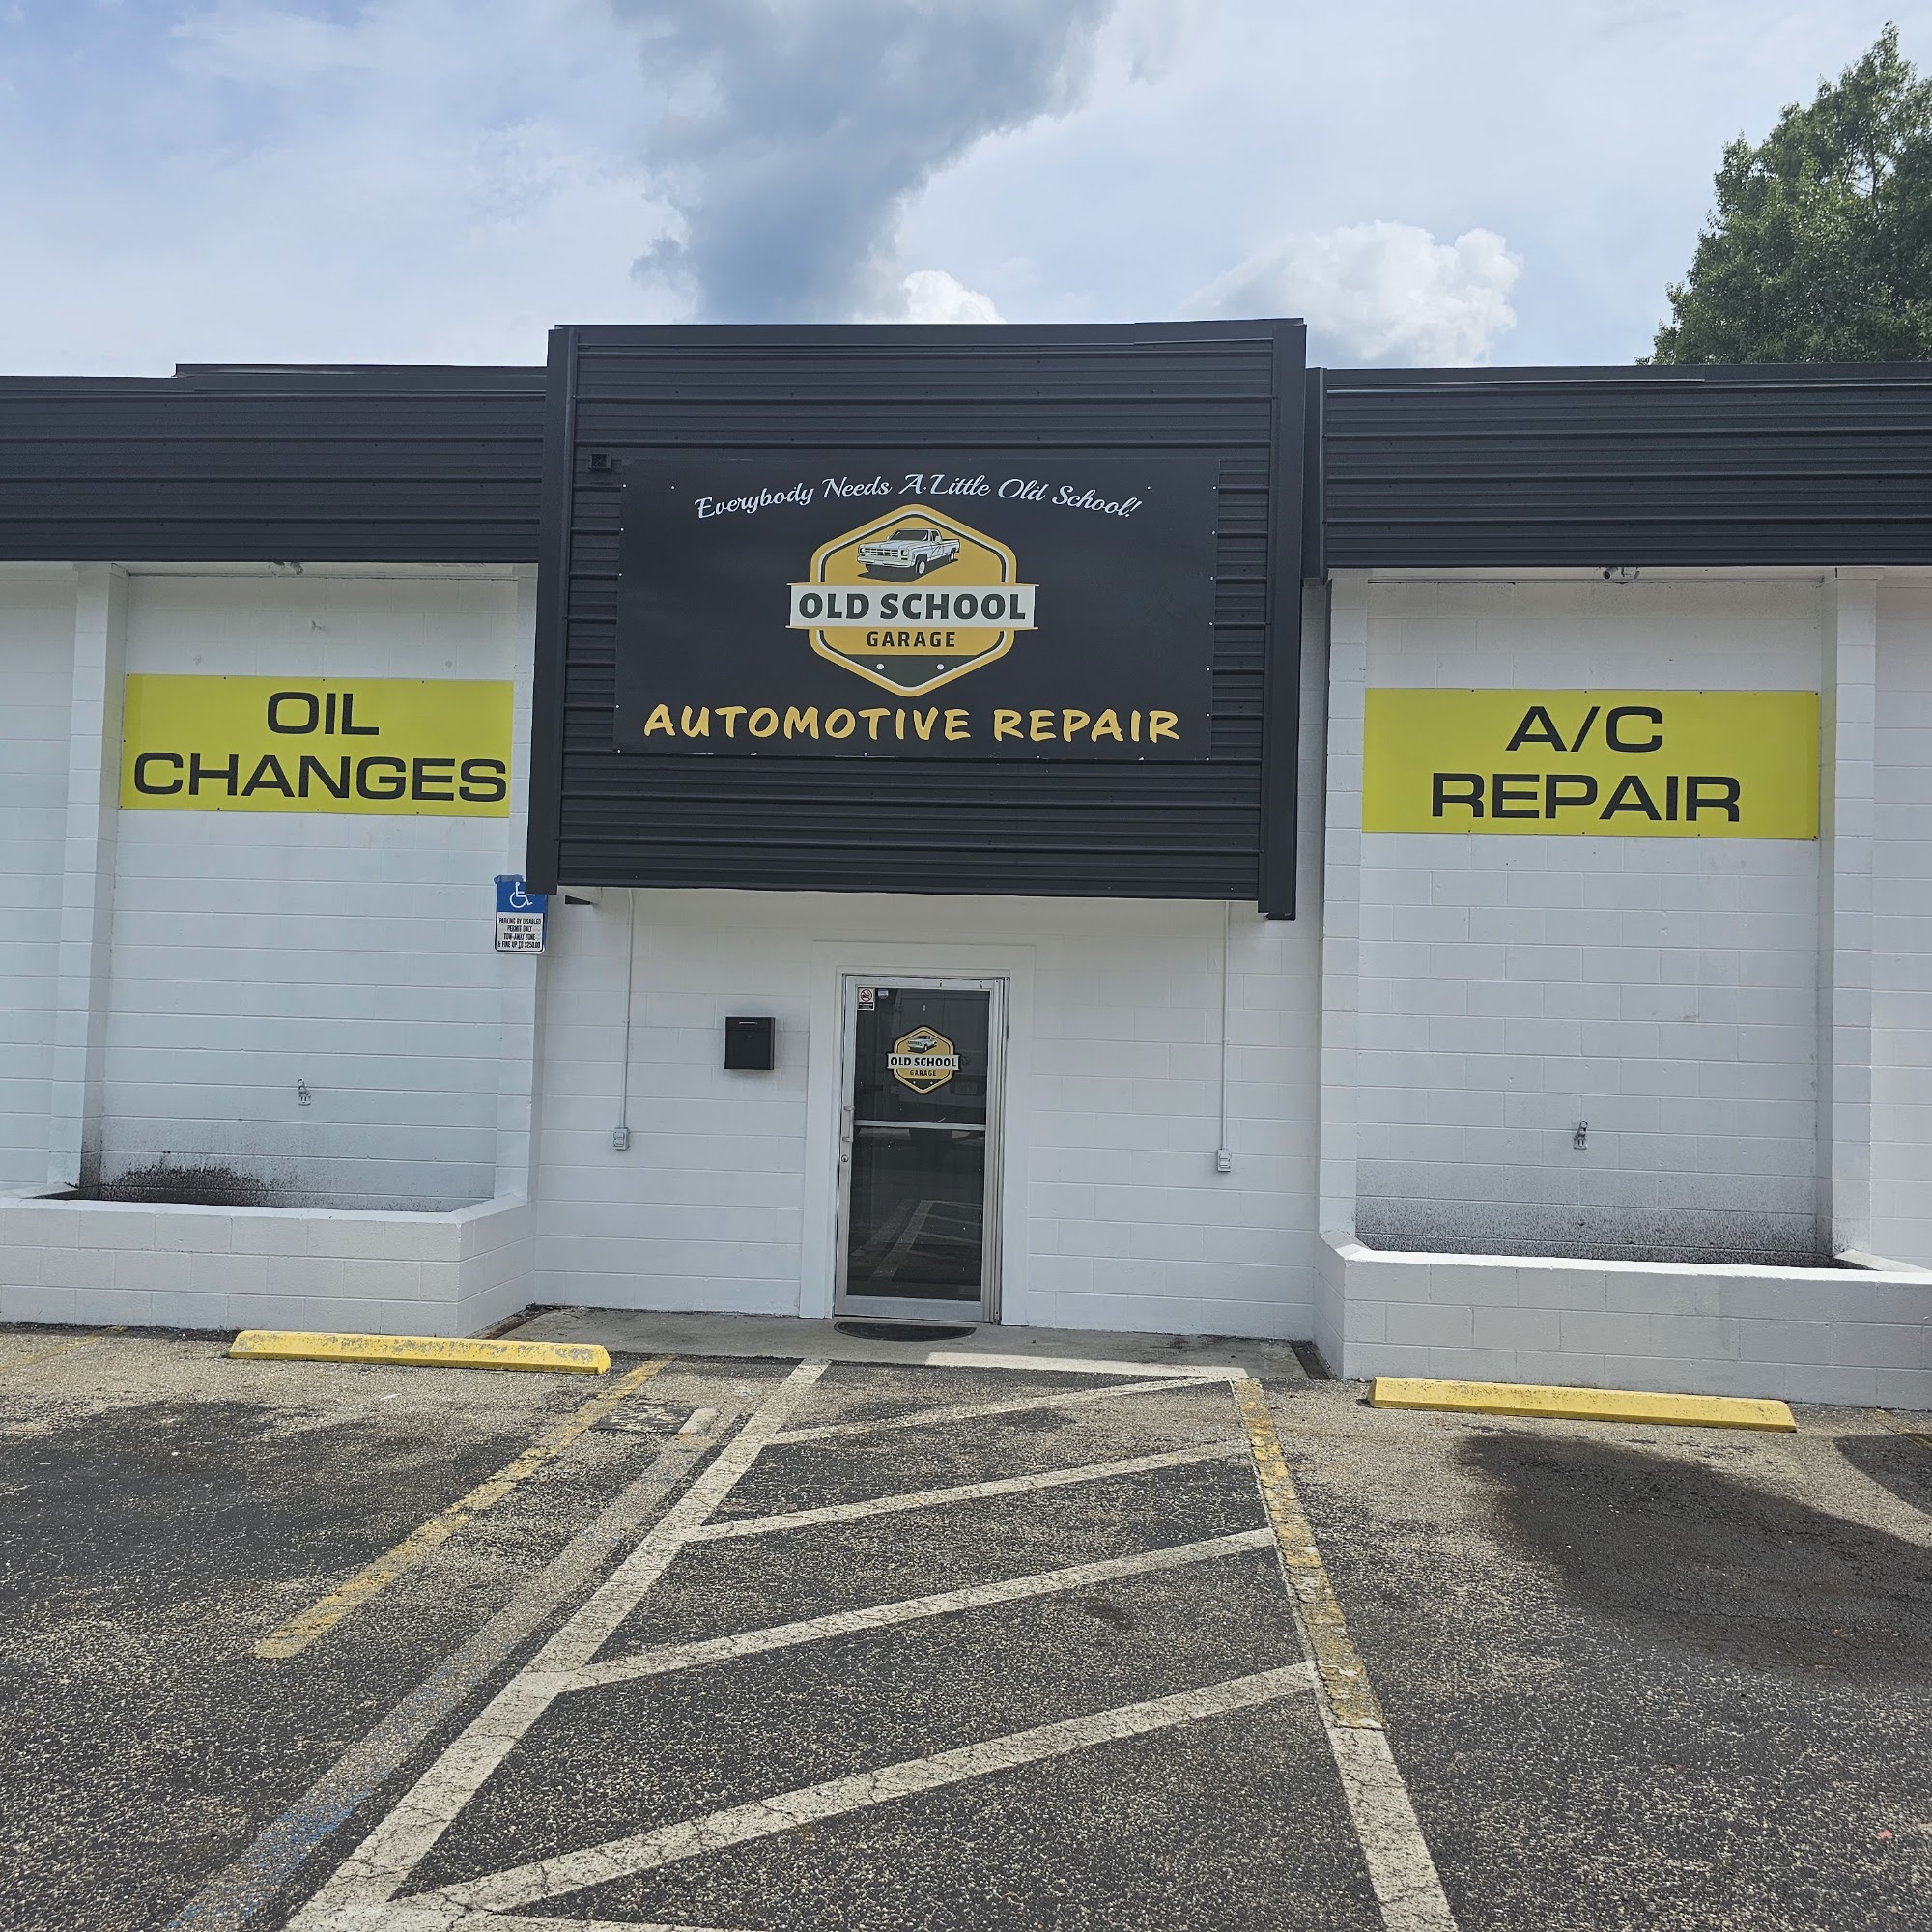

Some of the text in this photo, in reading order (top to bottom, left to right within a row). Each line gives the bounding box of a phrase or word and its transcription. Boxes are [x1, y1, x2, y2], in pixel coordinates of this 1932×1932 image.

[694, 473, 1143, 519] Everybody Needs A Little Old School!
[798, 592, 1027, 620] OLD SCHOOL
[867, 631, 956, 648] GARAGE
[267, 691, 380, 735] OIL
[643, 703, 1180, 744] AUTOMOTIVE REPAIR
[1505, 705, 1663, 753] A/C
[133, 752, 507, 802] CHANGES
[1432, 773, 1741, 822] REPAIR
[890, 1056, 956, 1067] OLD SCHOOL
